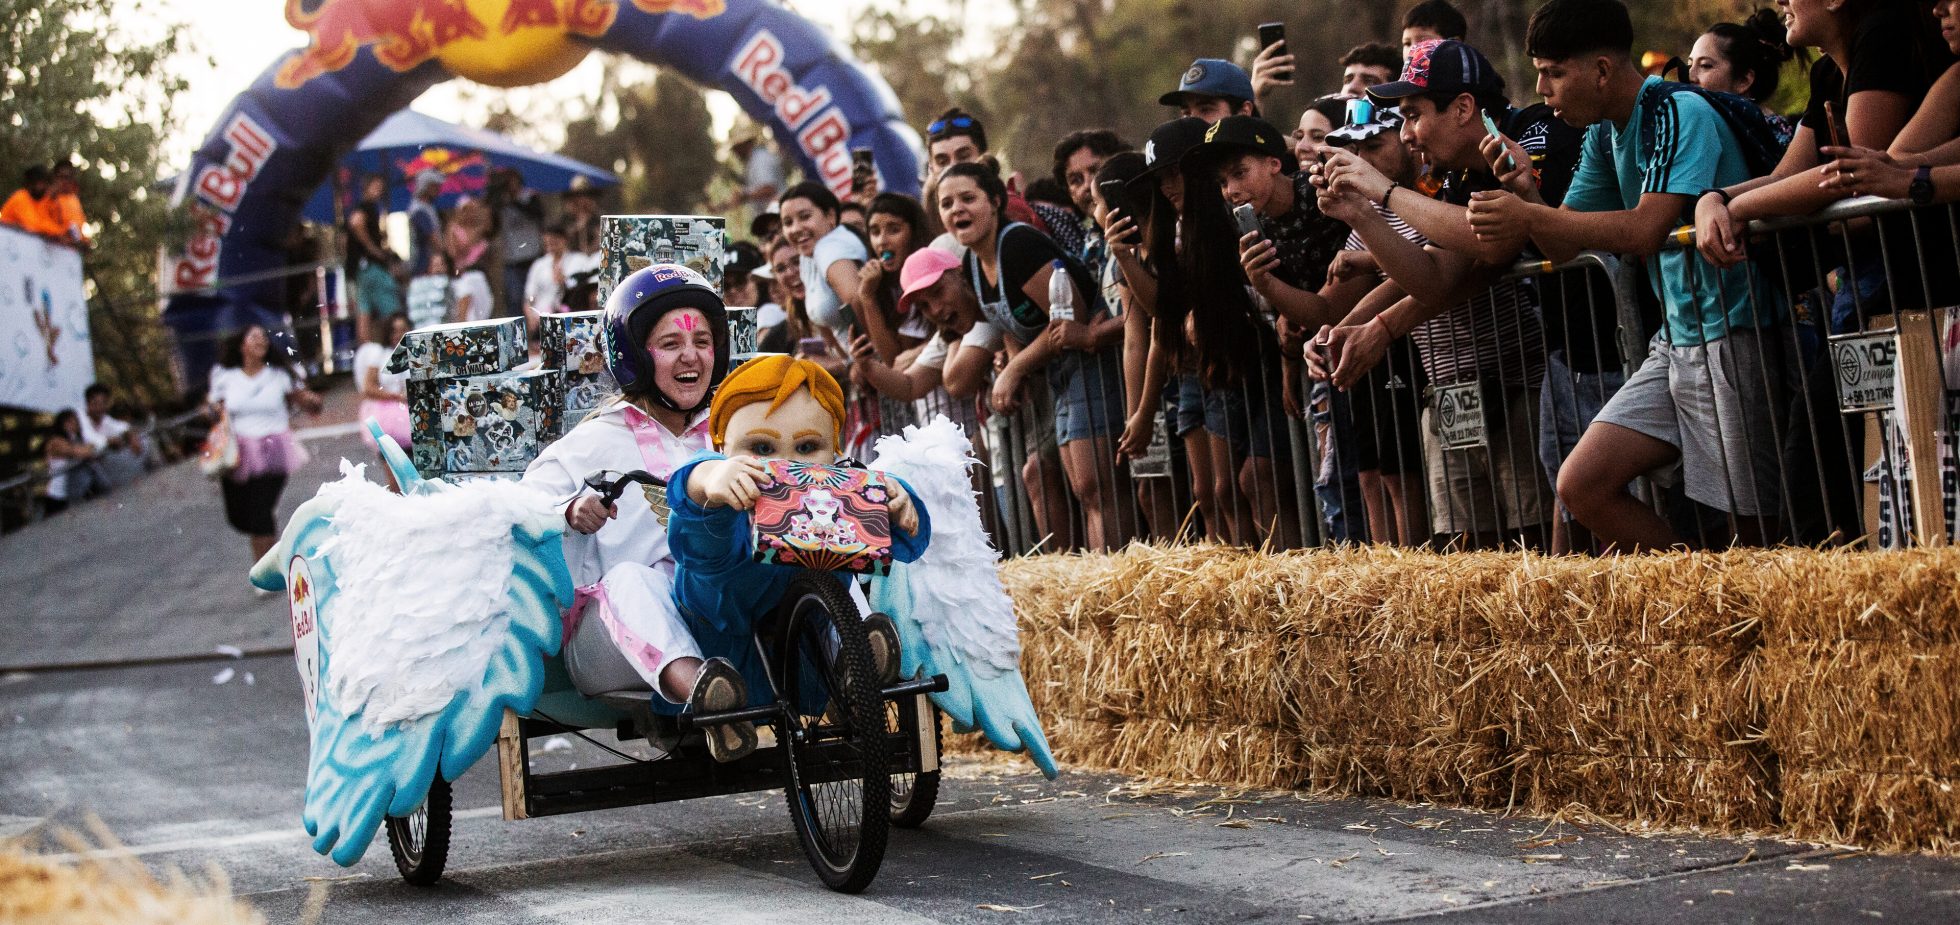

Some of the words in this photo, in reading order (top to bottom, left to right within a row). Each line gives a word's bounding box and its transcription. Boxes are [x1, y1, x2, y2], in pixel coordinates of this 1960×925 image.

[739, 39, 822, 128] Red
[804, 116, 854, 201] Bul
[200, 121, 270, 204] Bull
[655, 270, 680, 281] Red
[1860, 340, 1897, 367] VDS
[1455, 390, 1480, 411] VDS
